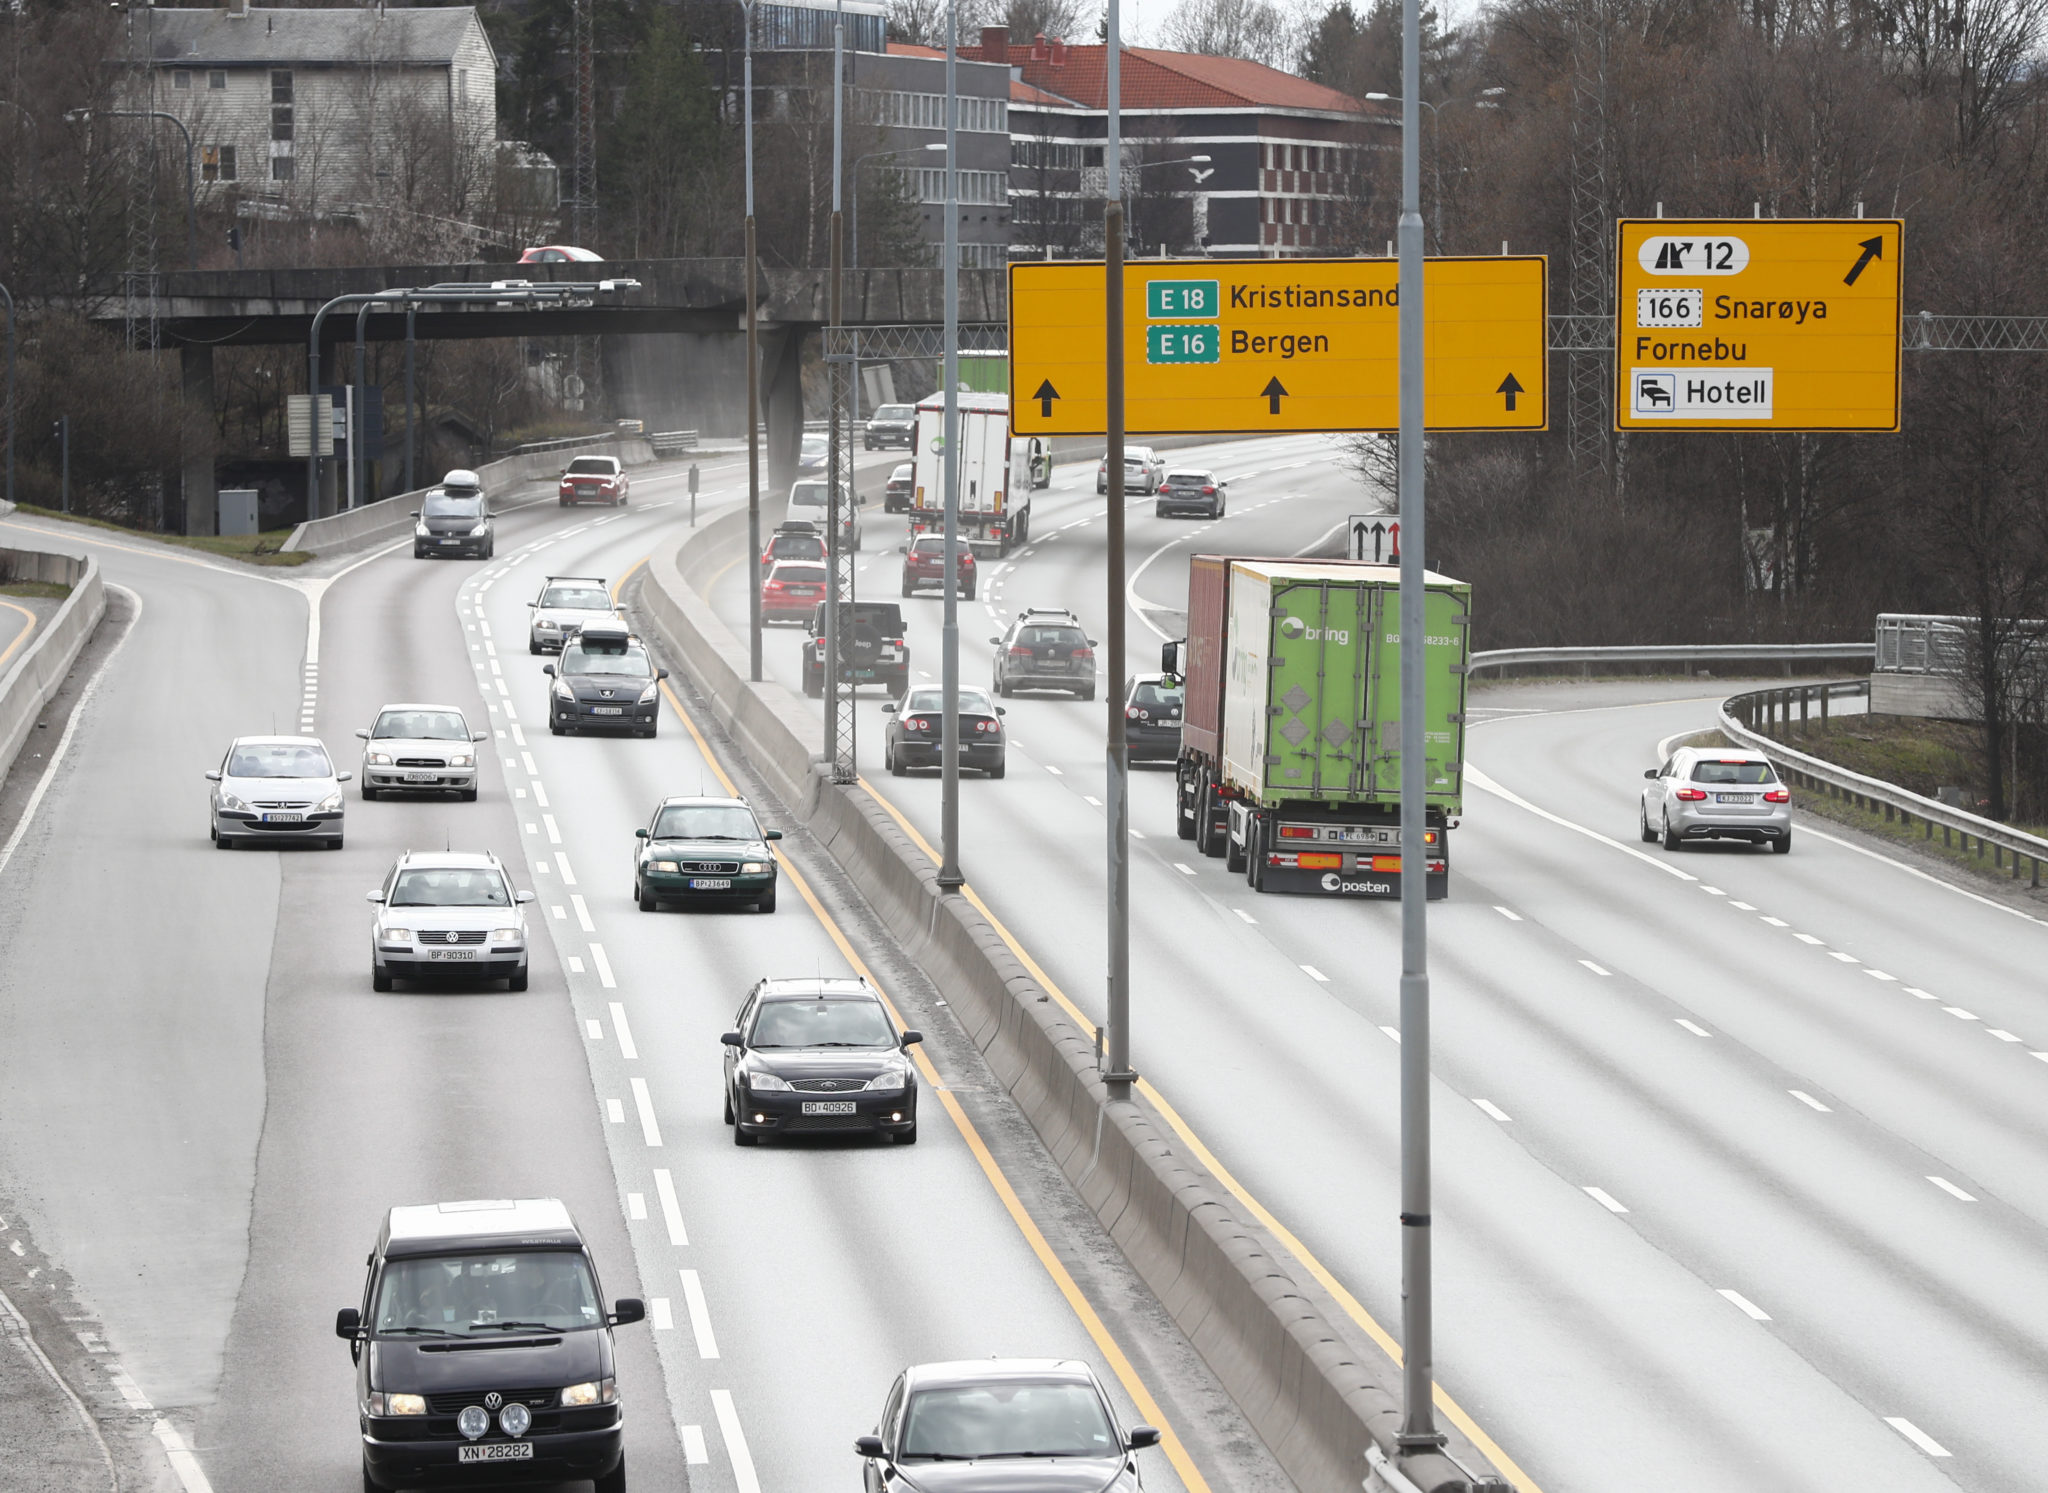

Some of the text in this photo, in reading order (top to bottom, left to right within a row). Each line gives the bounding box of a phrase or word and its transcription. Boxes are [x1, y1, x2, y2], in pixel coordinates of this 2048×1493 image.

[1703, 241, 1734, 270] 12
[1161, 288, 1205, 310] E 18
[1230, 282, 1399, 309] Kristiansand
[1648, 294, 1828, 326] 166 Snarøya
[1161, 333, 1205, 355] E 16
[1230, 329, 1329, 359] Bergen
[1636, 336, 1747, 361] Fornebu
[1686, 379, 1765, 404] Hotell
[1305, 625, 1349, 646] bring
[1386, 633, 1400, 643] BG
[708, 879, 730, 887] 23649
[1341, 880, 1391, 893] posten
[431, 951, 473, 960] BP 90310
[822, 1102, 854, 1112] 40926
[462, 1444, 529, 1460] XN 28282
